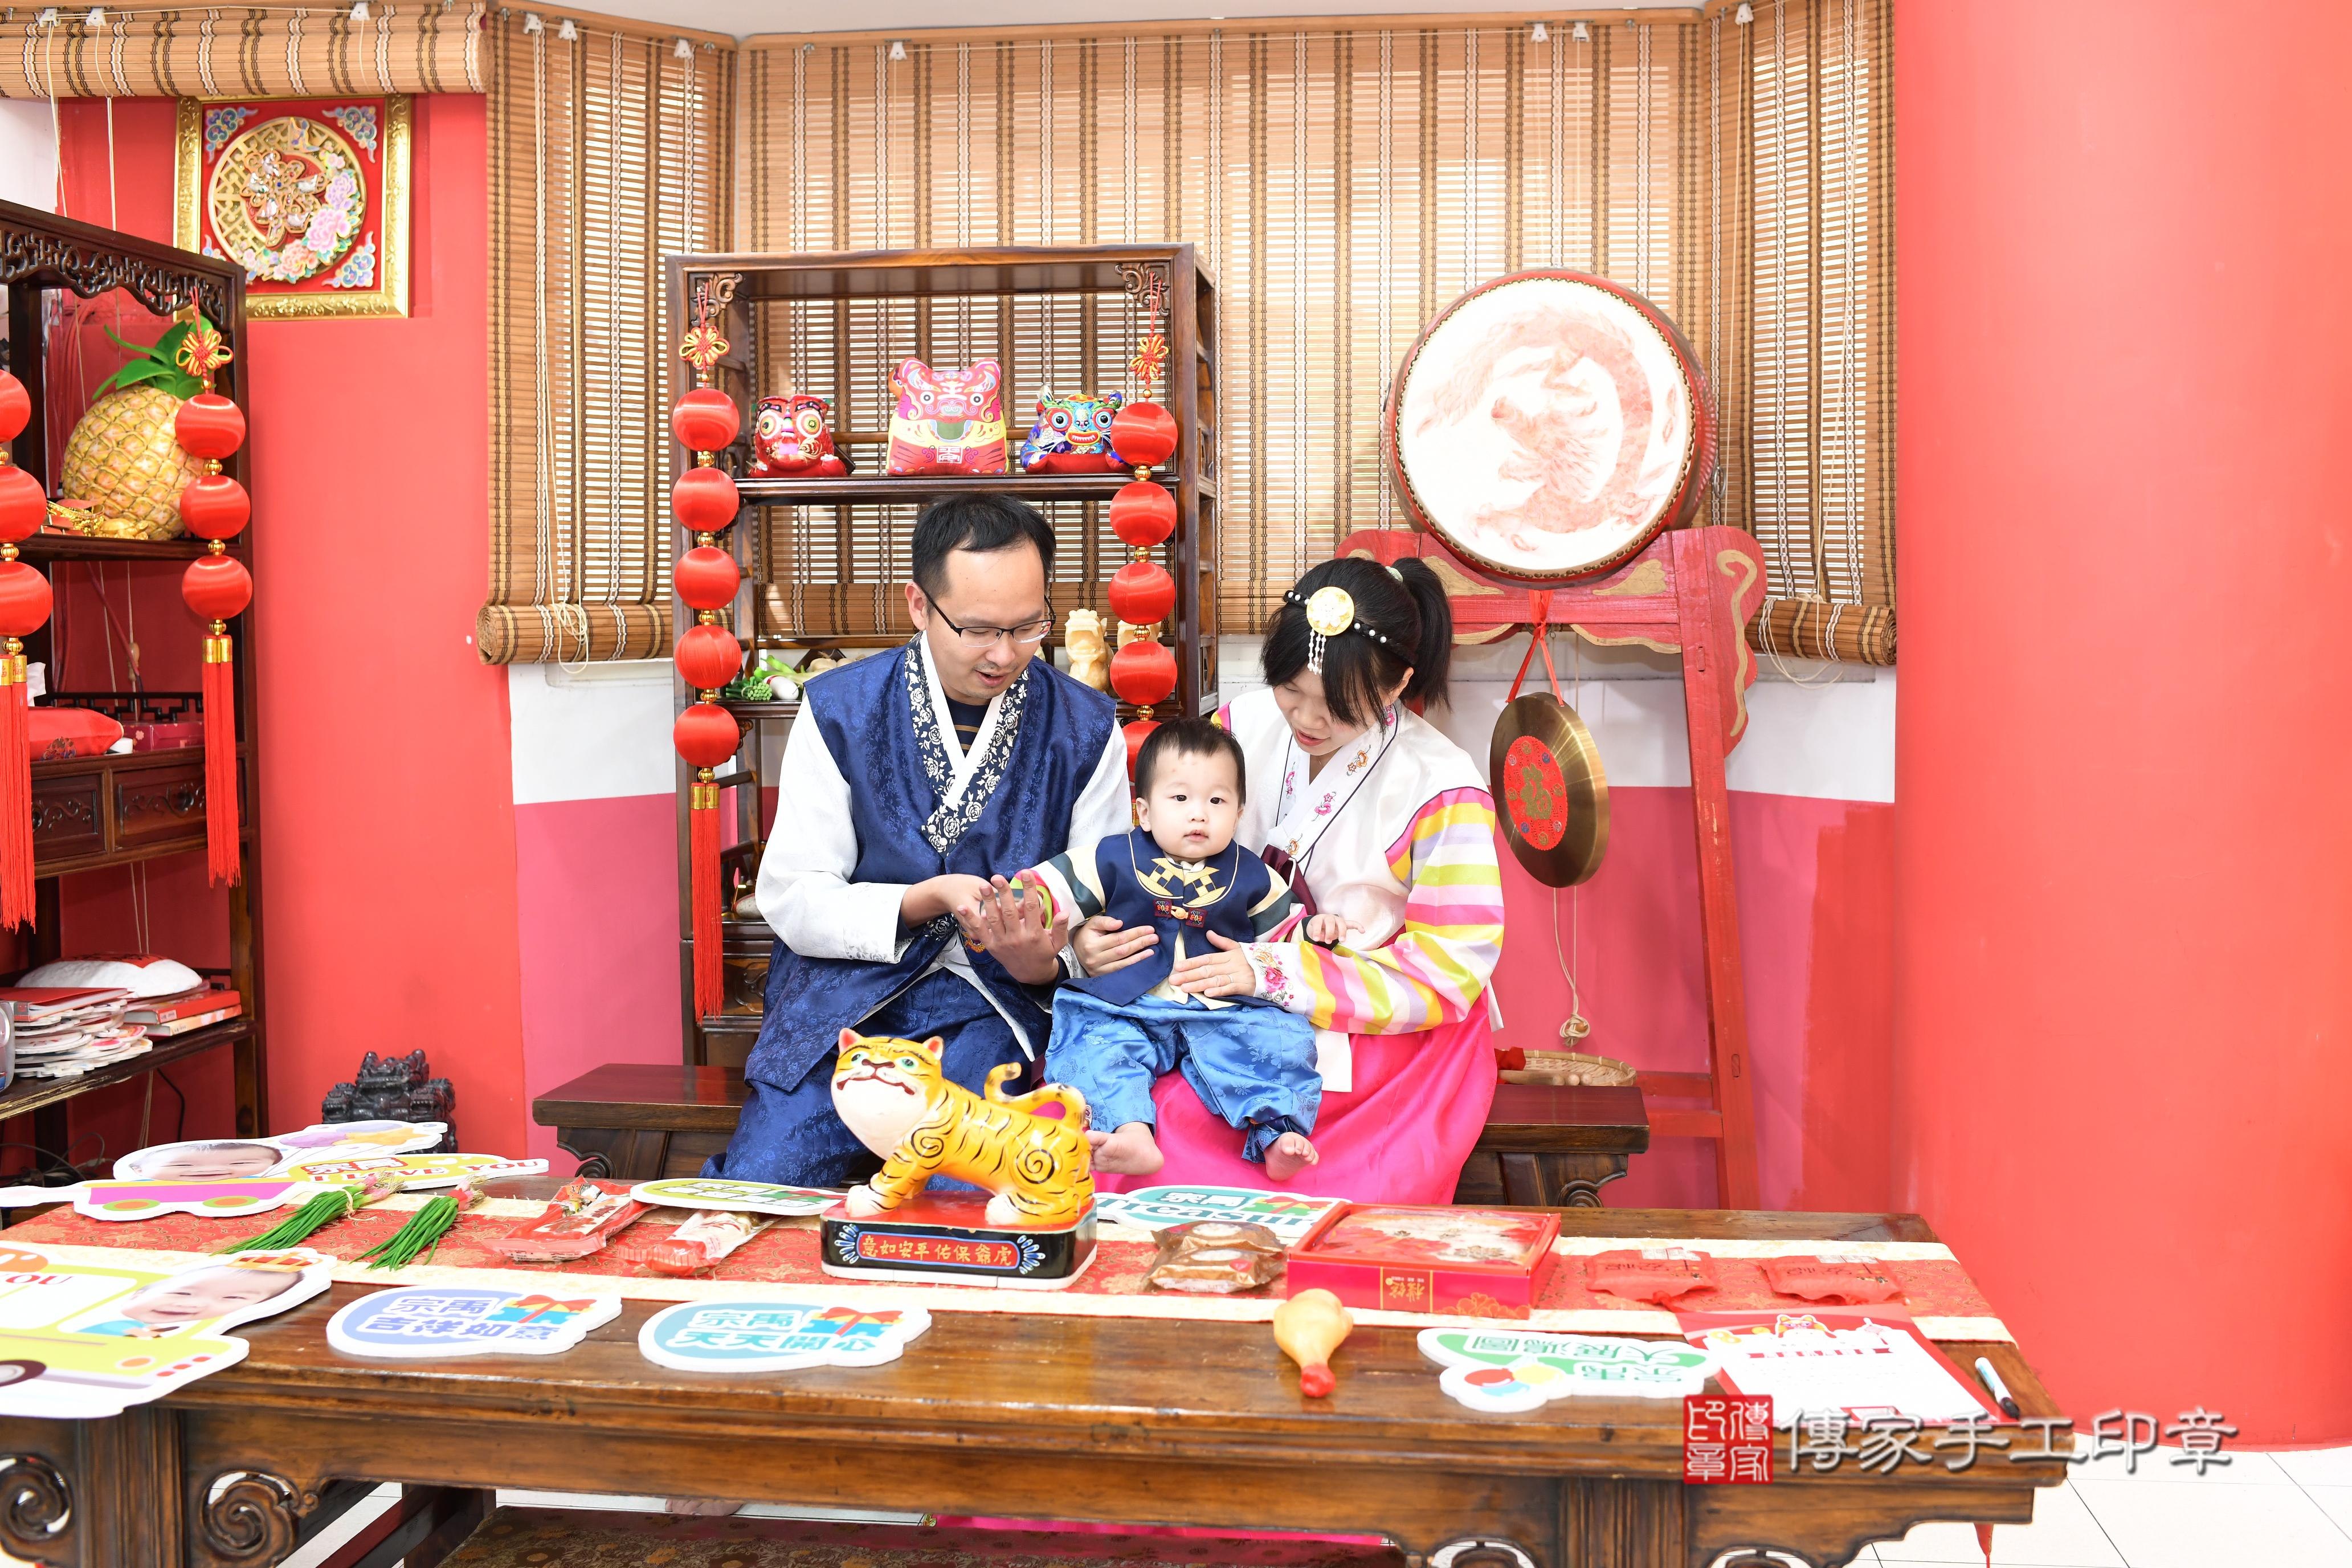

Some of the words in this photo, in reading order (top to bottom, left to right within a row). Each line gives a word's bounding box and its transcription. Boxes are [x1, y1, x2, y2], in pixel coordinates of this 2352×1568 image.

[466, 1161, 538, 1171] YOU
[1097, 1197, 1317, 1226] Treasur
[0, 1273, 74, 1285] OU
[365, 1316, 561, 1341] 吉祥如意
[680, 1331, 877, 1352] 天天開心
